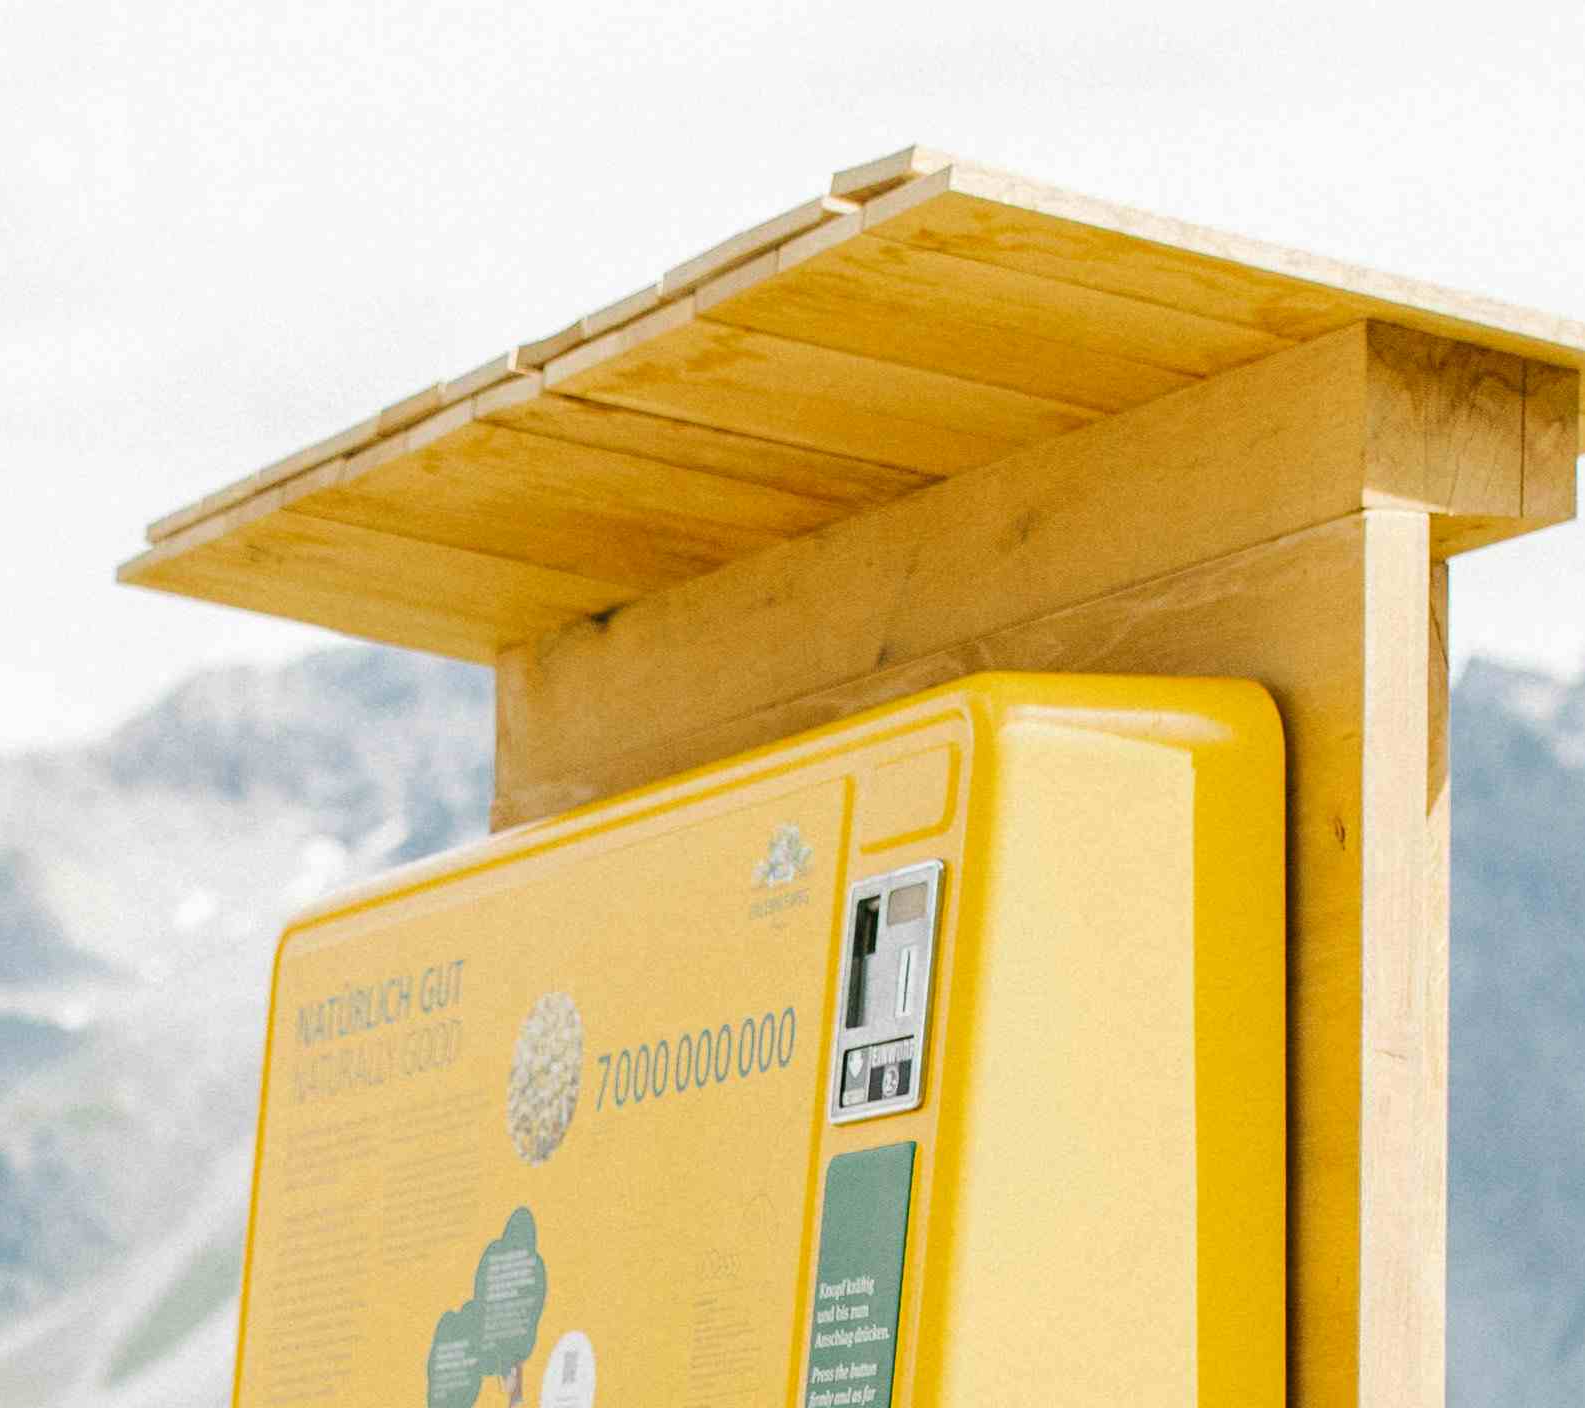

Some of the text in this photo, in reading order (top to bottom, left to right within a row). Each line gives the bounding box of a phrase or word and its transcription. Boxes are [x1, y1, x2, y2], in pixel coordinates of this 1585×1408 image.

[421, 959, 464, 1014] GUT
[819, 1279, 846, 1300] Knopf
[817, 1304, 869, 1323] und bis zum
[815, 1328, 853, 1349] Anschlag
[812, 1362, 878, 1384] Press the button
[834, 1387, 852, 1405] and
[852, 1391, 862, 1404] as
[861, 1385, 877, 1406] far
